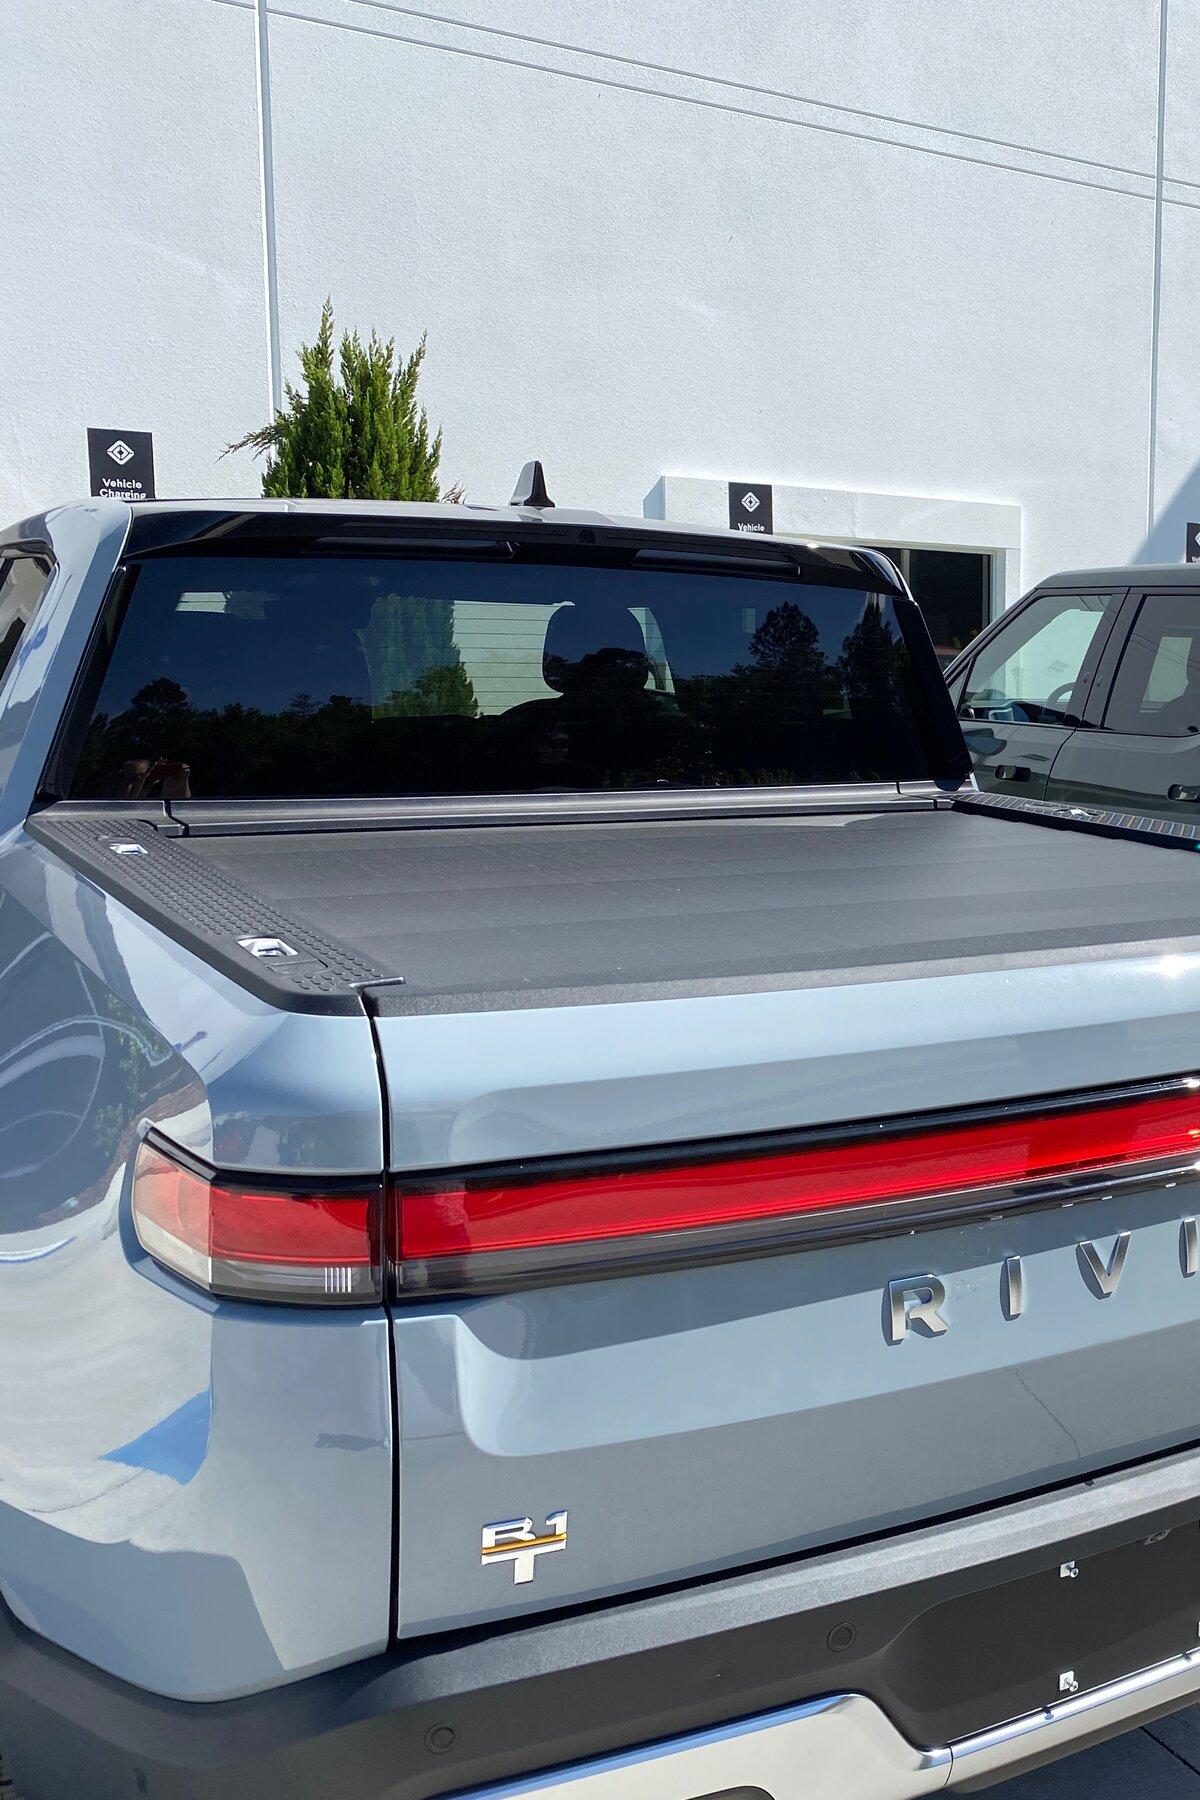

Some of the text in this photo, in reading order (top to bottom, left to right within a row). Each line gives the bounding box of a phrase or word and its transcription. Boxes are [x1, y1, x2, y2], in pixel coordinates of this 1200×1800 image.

[102, 478, 142, 488] Vehicle
[100, 489, 146, 499] Charging
[738, 523, 765, 532] Vehicle
